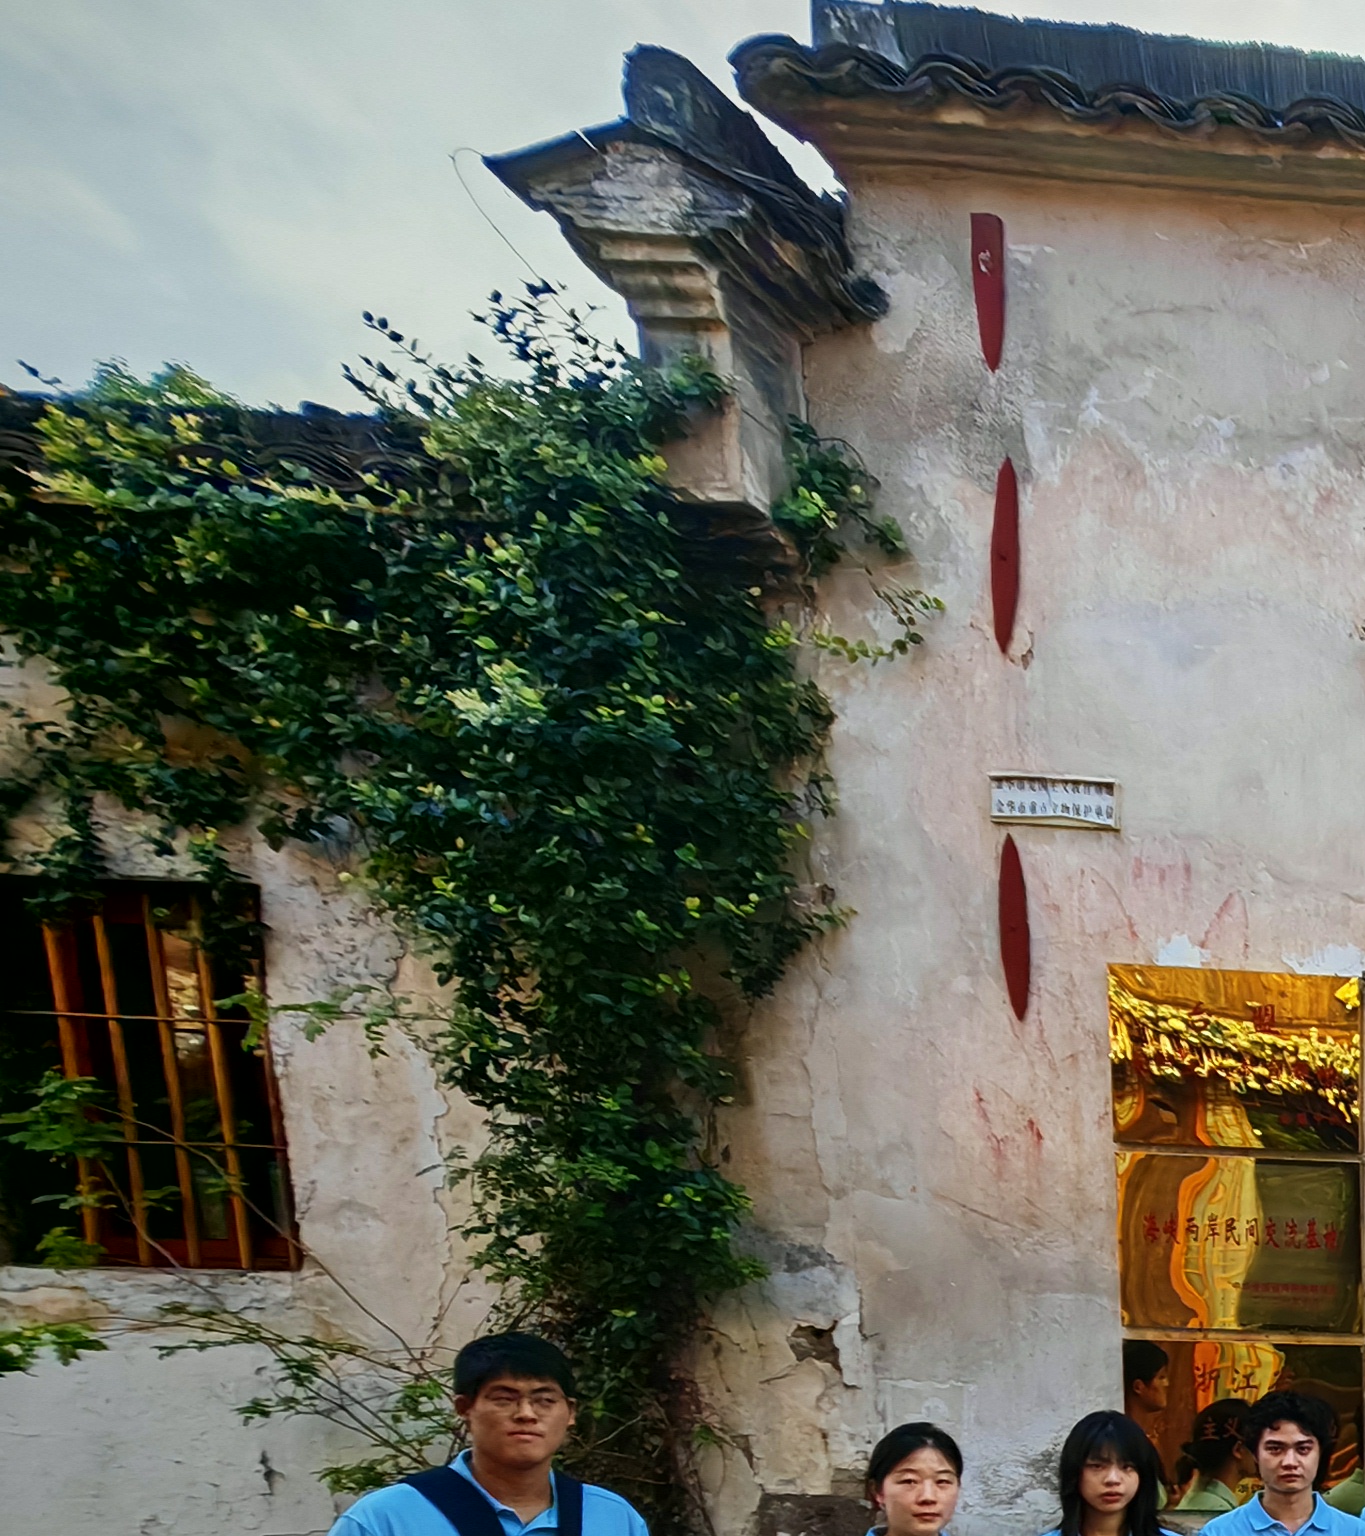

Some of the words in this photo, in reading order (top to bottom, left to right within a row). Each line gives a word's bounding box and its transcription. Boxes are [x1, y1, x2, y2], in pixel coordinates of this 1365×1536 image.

[1142, 1212, 1339, 1252] 海峡两岸民间交流基地
